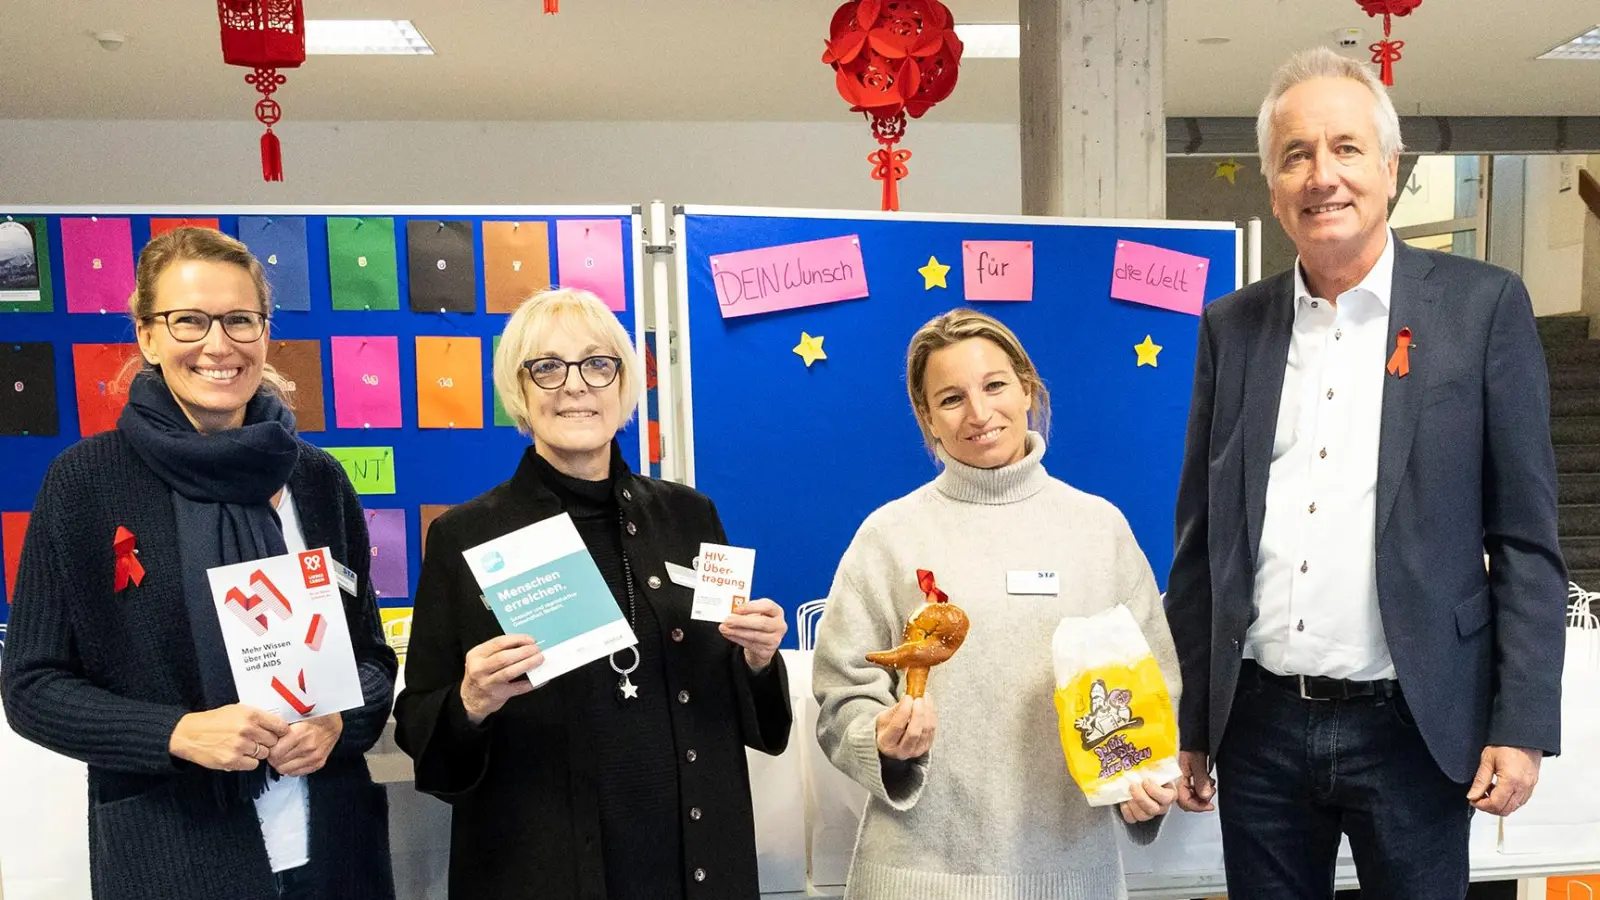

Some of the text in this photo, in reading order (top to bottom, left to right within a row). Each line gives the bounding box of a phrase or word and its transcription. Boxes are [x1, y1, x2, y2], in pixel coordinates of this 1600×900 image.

[93, 258, 102, 269] 2
[268, 254, 277, 265] 4
[512, 260, 521, 271] 7
[977, 251, 1009, 284] für
[714, 257, 853, 306] DEIN Wunsch
[1115, 263, 1189, 292] die Welt
[340, 458, 385, 482] NT
[704, 551, 728, 562] HIV-
[703, 560, 734, 574] Über-
[496, 571, 561, 601] Menschen
[702, 574, 745, 590] tragung
[504, 583, 567, 612] erreichen.
[241, 641, 291, 655] Mehr Wissen
[244, 650, 277, 663] über HIV
[246, 658, 282, 671] und AIDS
